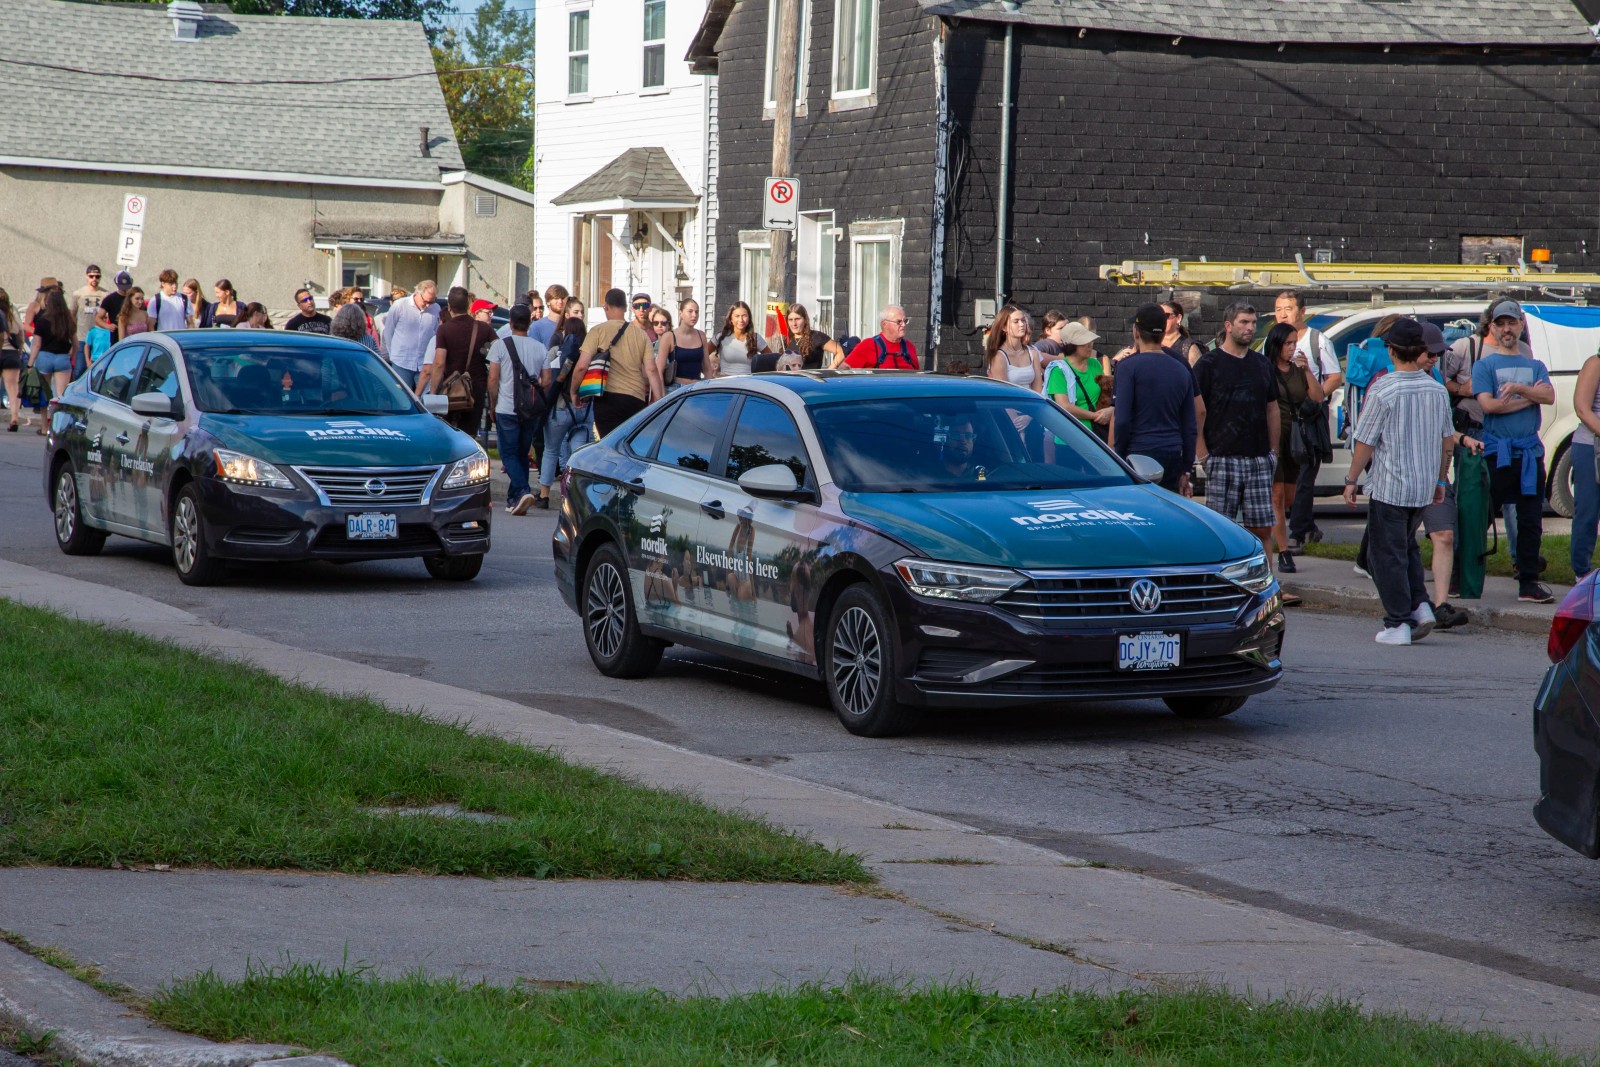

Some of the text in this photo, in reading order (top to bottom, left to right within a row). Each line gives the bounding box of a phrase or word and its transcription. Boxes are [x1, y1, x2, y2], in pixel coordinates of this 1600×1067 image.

[125, 237, 134, 249] P
[305, 427, 405, 437] nordik
[1010, 509, 1147, 526] nordik
[348, 519, 396, 533] DALR 847
[1026, 521, 1097, 531] SPA-NATURE
[641, 537, 668, 556] nordik
[696, 545, 743, 572] Elsewhere
[745, 556, 754, 575] is
[755, 557, 779, 580] here
[1120, 640, 1179, 661] DCJY 70
